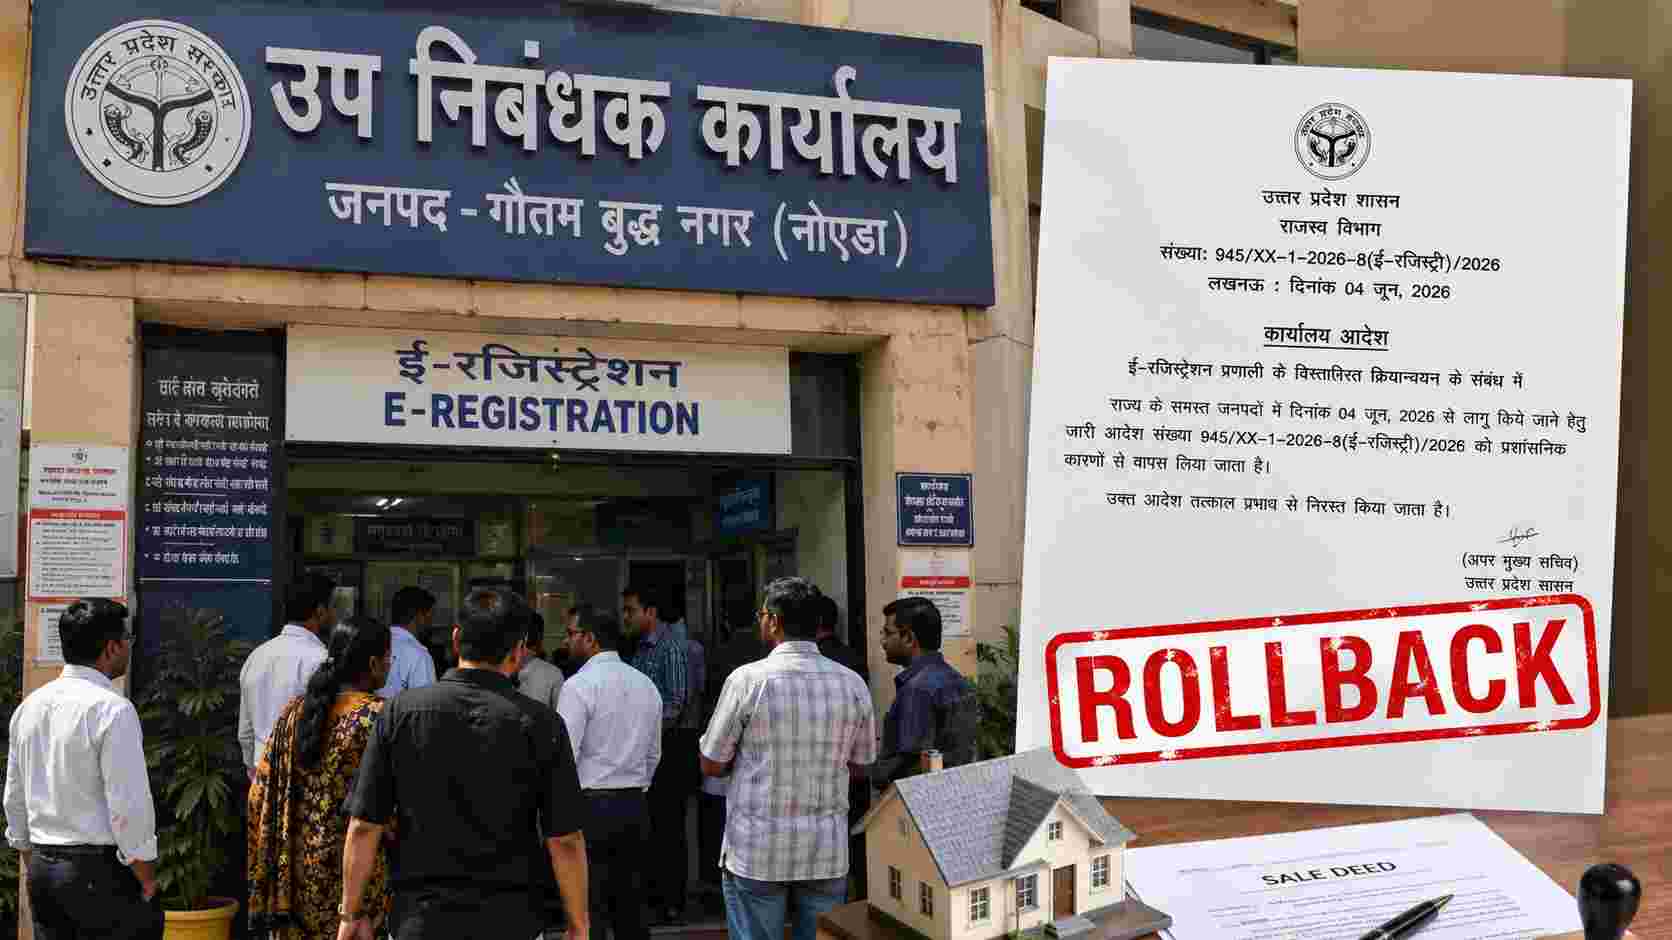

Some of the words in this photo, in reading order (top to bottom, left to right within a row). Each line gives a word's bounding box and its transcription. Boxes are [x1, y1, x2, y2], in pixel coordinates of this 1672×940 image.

[120, 29, 178, 56] प्रदेश
[265, 46, 381, 139] उप
[409, 26, 671, 160] निबंधक
[697, 65, 960, 184] कार्यालय
[1261, 190, 1302, 205] उत्तर
[1309, 187, 1348, 207] प्रदेश
[1355, 193, 1401, 209] शासन
[325, 182, 451, 233] जनपद
[486, 176, 584, 237] गौतम
[598, 200, 663, 256] बुद्ध
[676, 205, 754, 248] नगर
[774, 200, 908, 268] (नोएडा)
[1279, 219, 1329, 235] राजस्व
[1336, 216, 1382, 237] विभाग
[1207, 277, 1265, 292] लखनऊ
[1288, 275, 1337, 295] दिनांक
[1344, 281, 1365, 296] 04
[1372, 282, 1403, 302] जून,
[1411, 284, 1451, 300] 2026
[1263, 321, 1332, 344] कार्यालय
[1339, 323, 1390, 346] आदेश
[1221, 361, 1265, 379] प्रणाली
[1271, 362, 1287, 380] के
[1370, 365, 1441, 386] क्रियान्वयन
[1447, 368, 1463, 386] के
[1469, 370, 1505, 388] संबंध
[1511, 371, 1523, 389] में
[384, 391, 700, 436] E-REGISTRATION
[1109, 398, 1142, 412] राज्य
[1149, 396, 1163, 413] के
[1170, 400, 1211, 415] समस्त
[1217, 400, 1264, 417] जनपदों
[1271, 400, 1283, 418] में
[1289, 400, 1332, 419] दिनांक
[1338, 407, 1356, 420] 04
[1364, 408, 1391, 426] जून,
[1399, 409, 1435, 423] 2026
[1442, 407, 1455, 425] से
[1497, 408, 1525, 427] किये
[1531, 410, 1560, 428] जाने
[1566, 411, 1587, 434] हेतु
[1065, 421, 1097, 439] जारी
[1104, 423, 1145, 441] आदेश
[1152, 425, 1193, 443] संख्या
[1474, 436, 1494, 454] को
[1063, 450, 1106, 468] कारणों
[1112, 451, 1125, 469] से
[1132, 456, 1169, 470] वापस
[1175, 453, 1207, 472] लिया
[1213, 459, 1246, 473] जाता
[1106, 492, 1137, 506] उक्त
[1143, 490, 1183, 508] आदेश
[1284, 495, 1299, 512] से
[1306, 495, 1347, 513] निरस्त
[1354, 497, 1387, 515] किया
[1393, 503, 1426, 517] जाता
[1462, 551, 1497, 569] (अपर
[1538, 553, 1579, 573] सचिव)
[1463, 576, 1496, 590] उत्तर
[1501, 575, 1532, 592] प्रदेश
[1074, 618, 1576, 744] ROLLBACK
[1262, 870, 1325, 887] SALE
[1334, 859, 1398, 879] DEED
